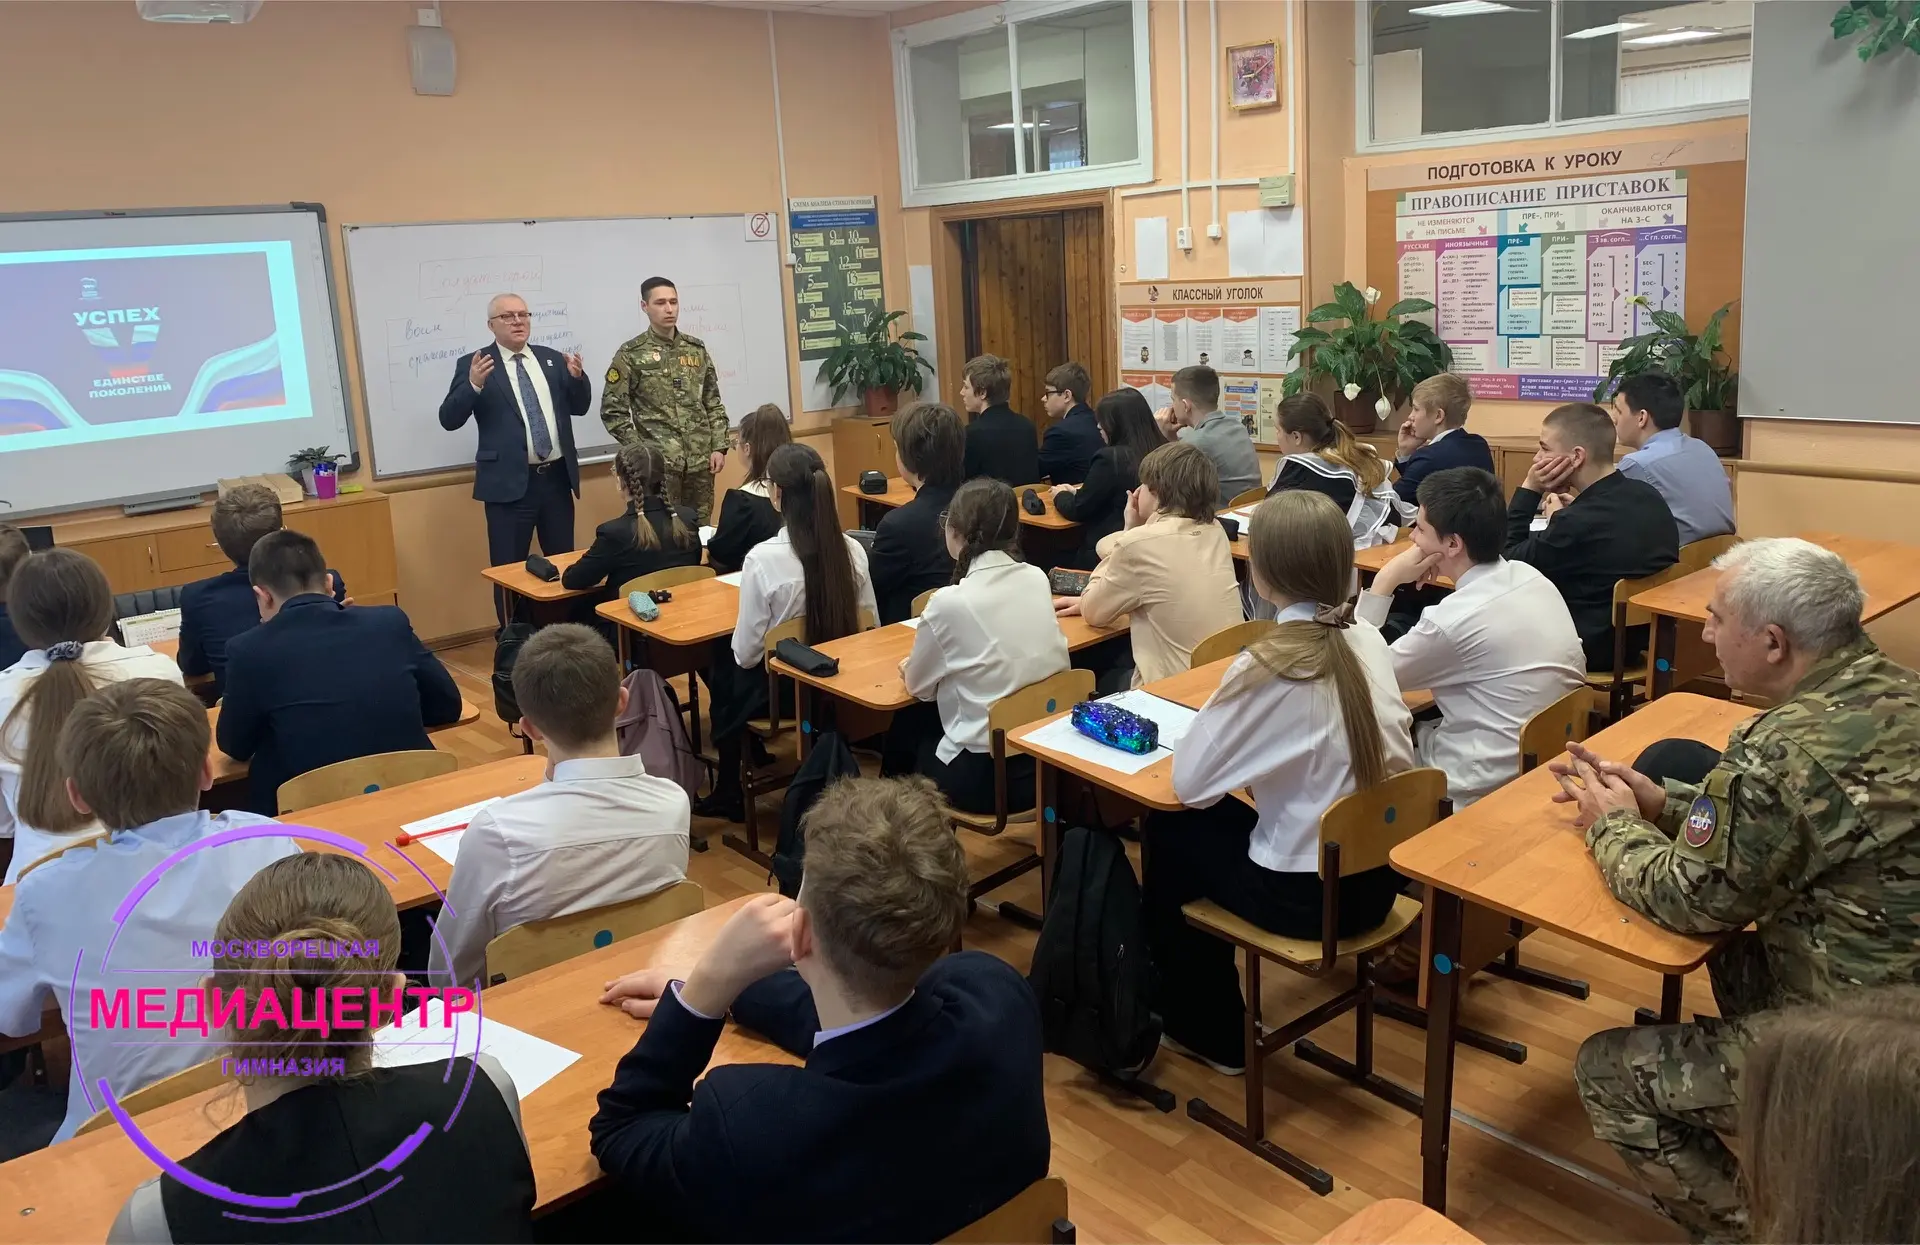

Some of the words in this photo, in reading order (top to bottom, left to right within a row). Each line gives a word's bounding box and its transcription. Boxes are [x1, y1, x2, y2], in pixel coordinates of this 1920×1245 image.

[1428, 158, 1535, 180] ПОДГОТОВКА
[1545, 156, 1555, 170] К
[1564, 150, 1622, 169] УРОКУ
[1411, 188, 1546, 210] ПРАВОПИСАНИЕ
[1556, 178, 1670, 200] ПРИСТАВОК
[1602, 204, 1672, 215] ОКАНЧИВАЮТСЯ
[1428, 216, 1475, 226] ИЗМЕНЯЮТСЯ
[794, 232, 800, 246] 8
[830, 230, 836, 244] 9
[848, 230, 859, 244] 10
[1173, 286, 1222, 300] КЛАССНЫЙ
[1226, 287, 1264, 300] УГОЛОК
[73, 307, 161, 326] УСПЕХ
[93, 374, 164, 388] ЕДИНСТВЕ
[88, 382, 172, 398] ПОКОЛЕНИЙ
